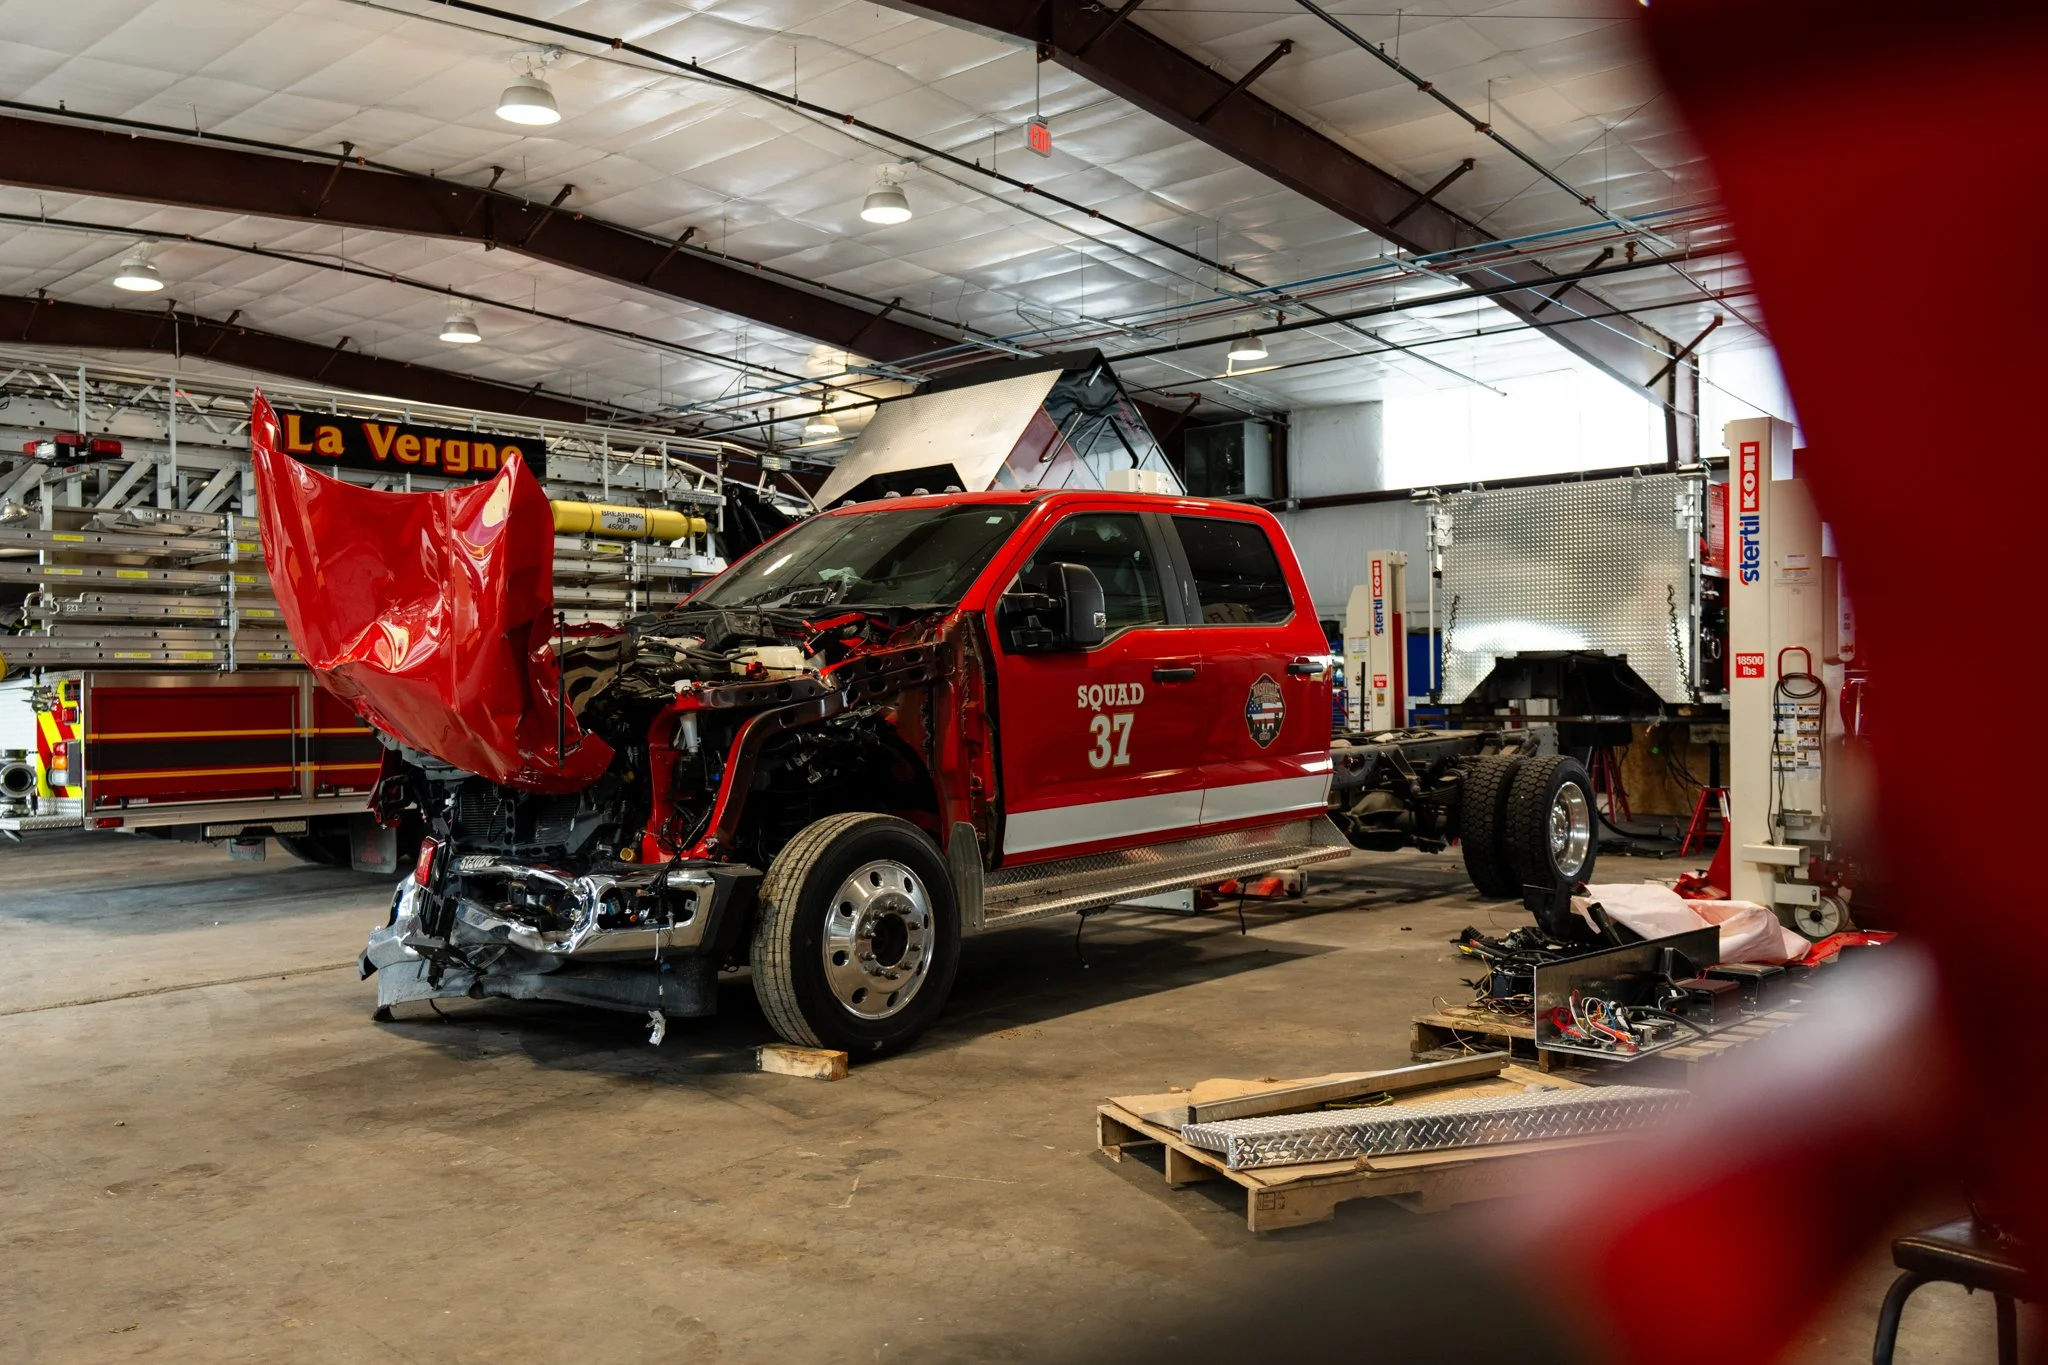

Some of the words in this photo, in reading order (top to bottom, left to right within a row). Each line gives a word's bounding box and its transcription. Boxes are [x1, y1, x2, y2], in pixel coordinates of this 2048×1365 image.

[1031, 126, 1049, 155] EXIT
[283, 413, 345, 456] La
[1742, 445, 1756, 509] KONI
[601, 510, 644, 519] BREATHING
[616, 517, 631, 525] AIR
[1739, 515, 1760, 586] stertil
[1373, 562, 1382, 596] KONI
[1373, 599, 1384, 637] stertil
[1736, 655, 1764, 666] 18500
[1743, 665, 1757, 676] lbs
[1077, 682, 1145, 712] SQUAD
[1088, 712, 1135, 769] 37
